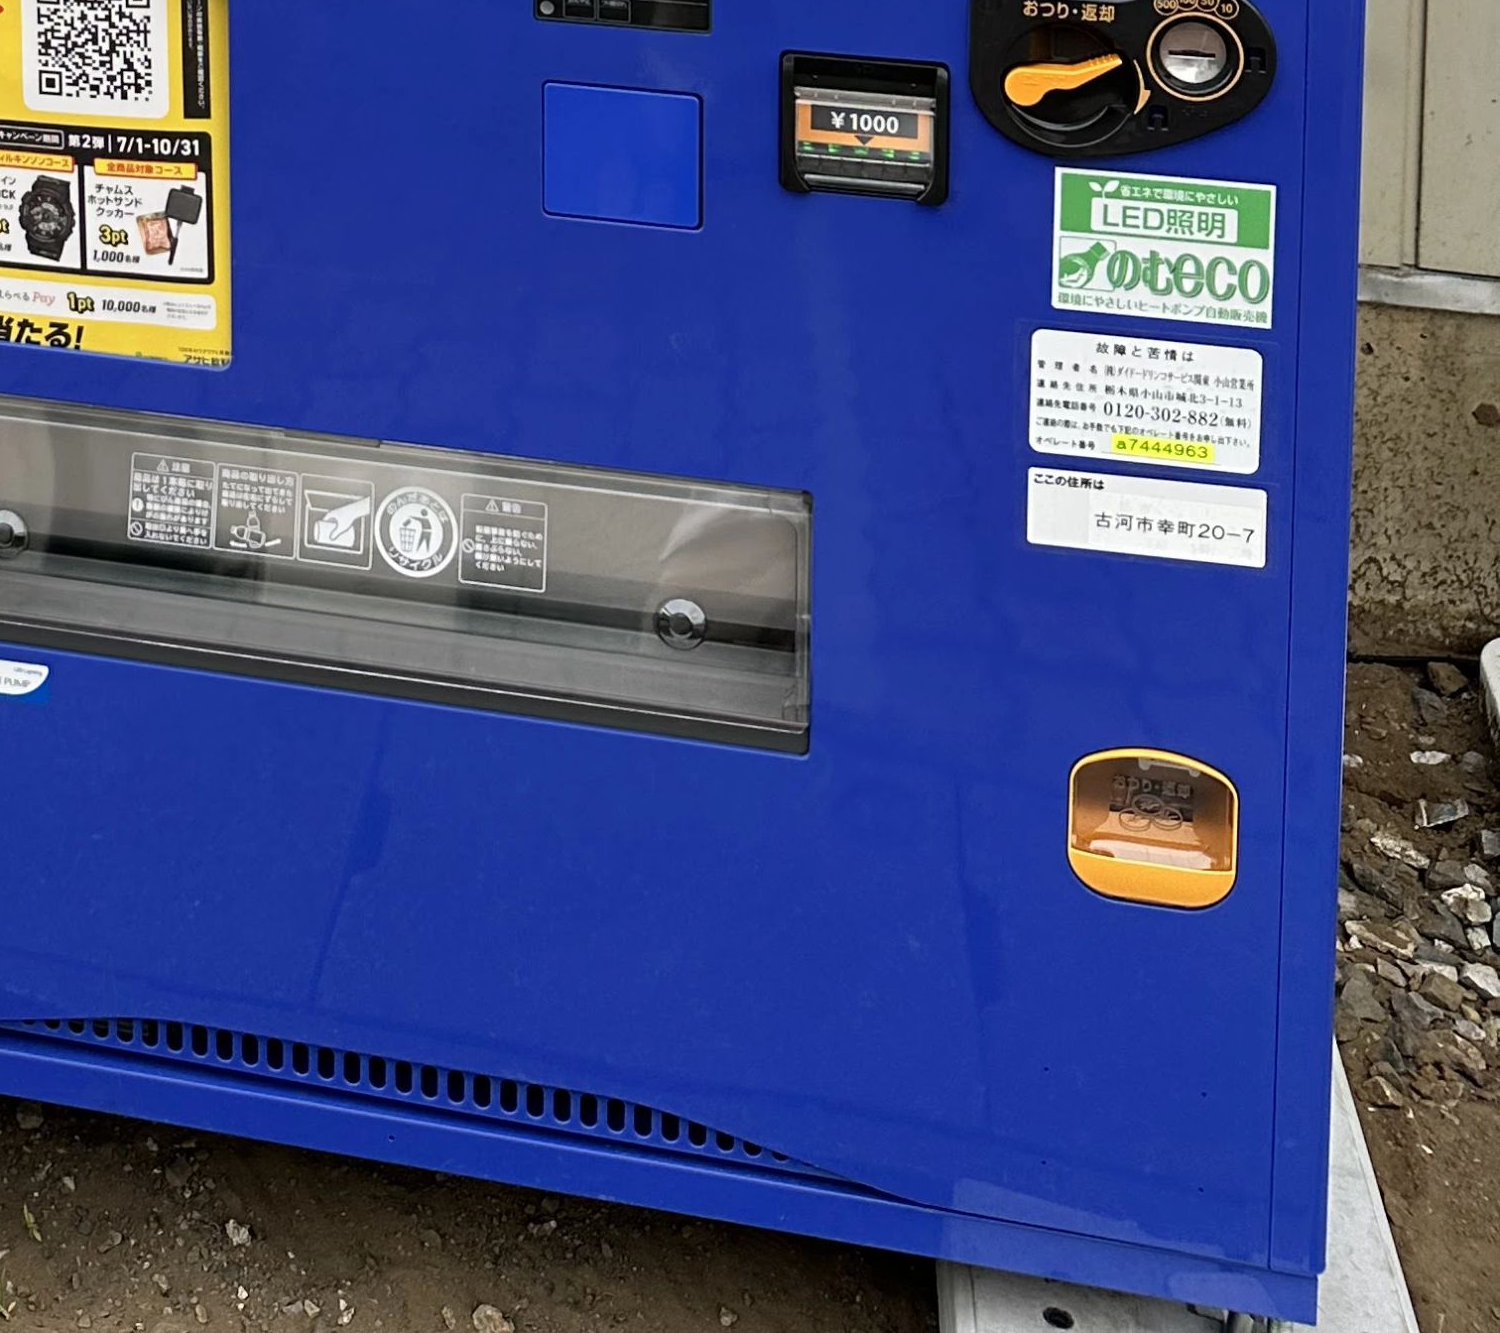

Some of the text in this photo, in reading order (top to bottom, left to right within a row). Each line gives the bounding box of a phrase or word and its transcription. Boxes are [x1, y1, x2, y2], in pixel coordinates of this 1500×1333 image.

[1023, 1, 1115, 22] おつり・返却
[1221, 3, 1232, 13] 10
[69, 135, 199, 156] 第2弾 7/1-10/31
[107, 163, 182, 175] 全商品対象コース
[1120, 185, 1238, 205] 省エネで環境にやさしい
[1103, 205, 1225, 239] LED照明
[99, 225, 128, 245] 3pt
[1107, 250, 1270, 304] のむeco
[1116, 440, 1209, 459] a7444963
[1034, 474, 1105, 490] ここの住所は
[1094, 512, 1255, 544] 古河市幸町20-7
